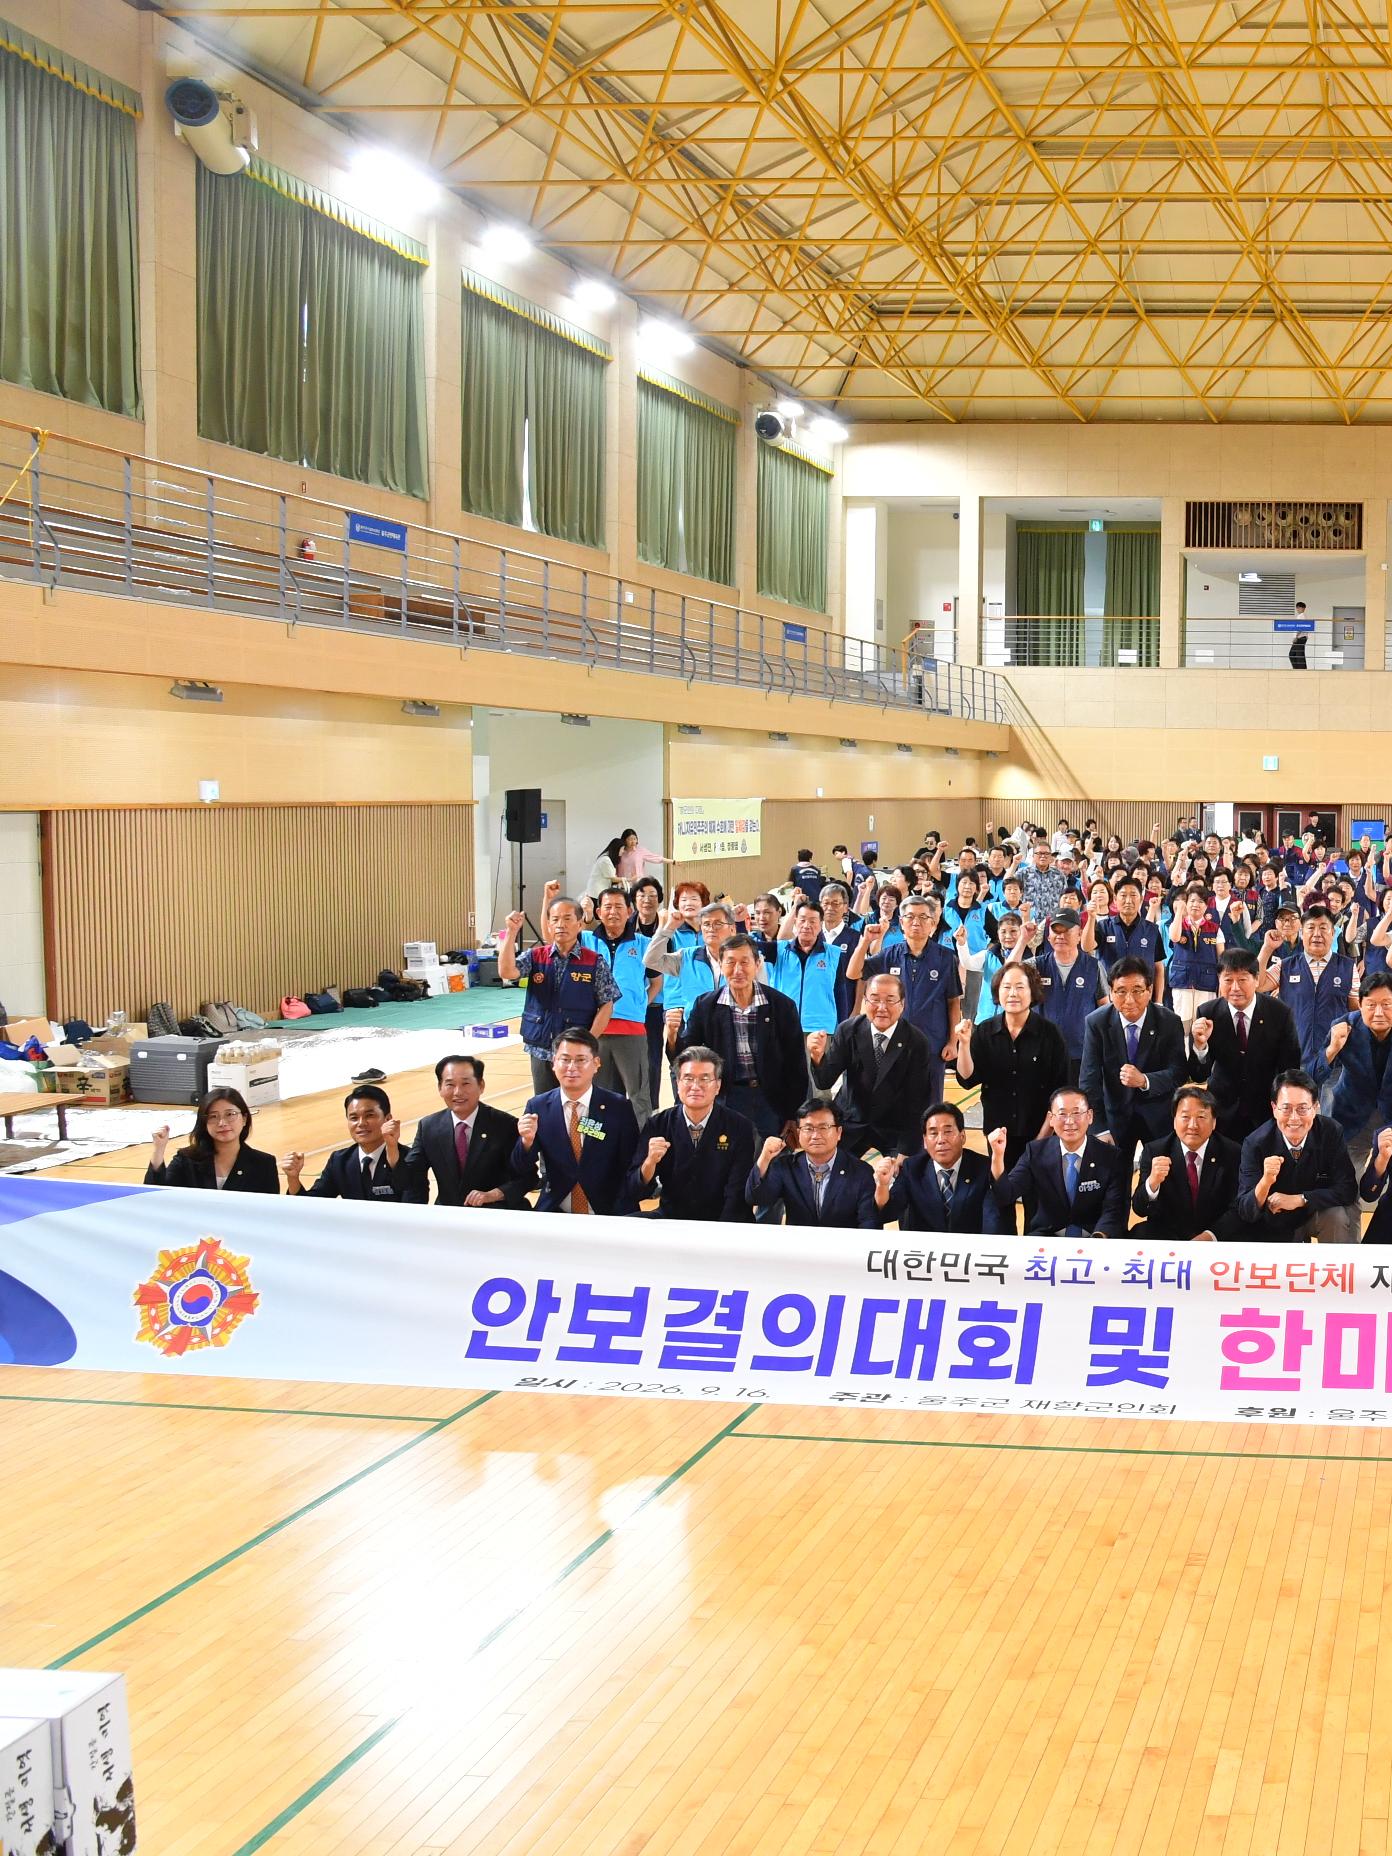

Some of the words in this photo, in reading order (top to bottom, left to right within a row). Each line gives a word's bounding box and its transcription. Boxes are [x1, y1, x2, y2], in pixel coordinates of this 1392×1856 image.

[867, 1249, 1009, 1286] 대한민국
[1209, 1260, 1356, 1296] 안보단체
[465, 1277, 1043, 1385] 안보결의대회
[1086, 1306, 1174, 1390] 및
[514, 1376, 577, 1389] 일시
[597, 1380, 686, 1396] 2026.
[700, 1386, 720, 1396] 9.
[734, 1386, 771, 1399] 16.
[828, 1391, 892, 1404] 주관
[916, 1394, 1010, 1410] 울주군
[1018, 1398, 1178, 1416] 재향군인회
[1234, 1406, 1297, 1419] 후원
